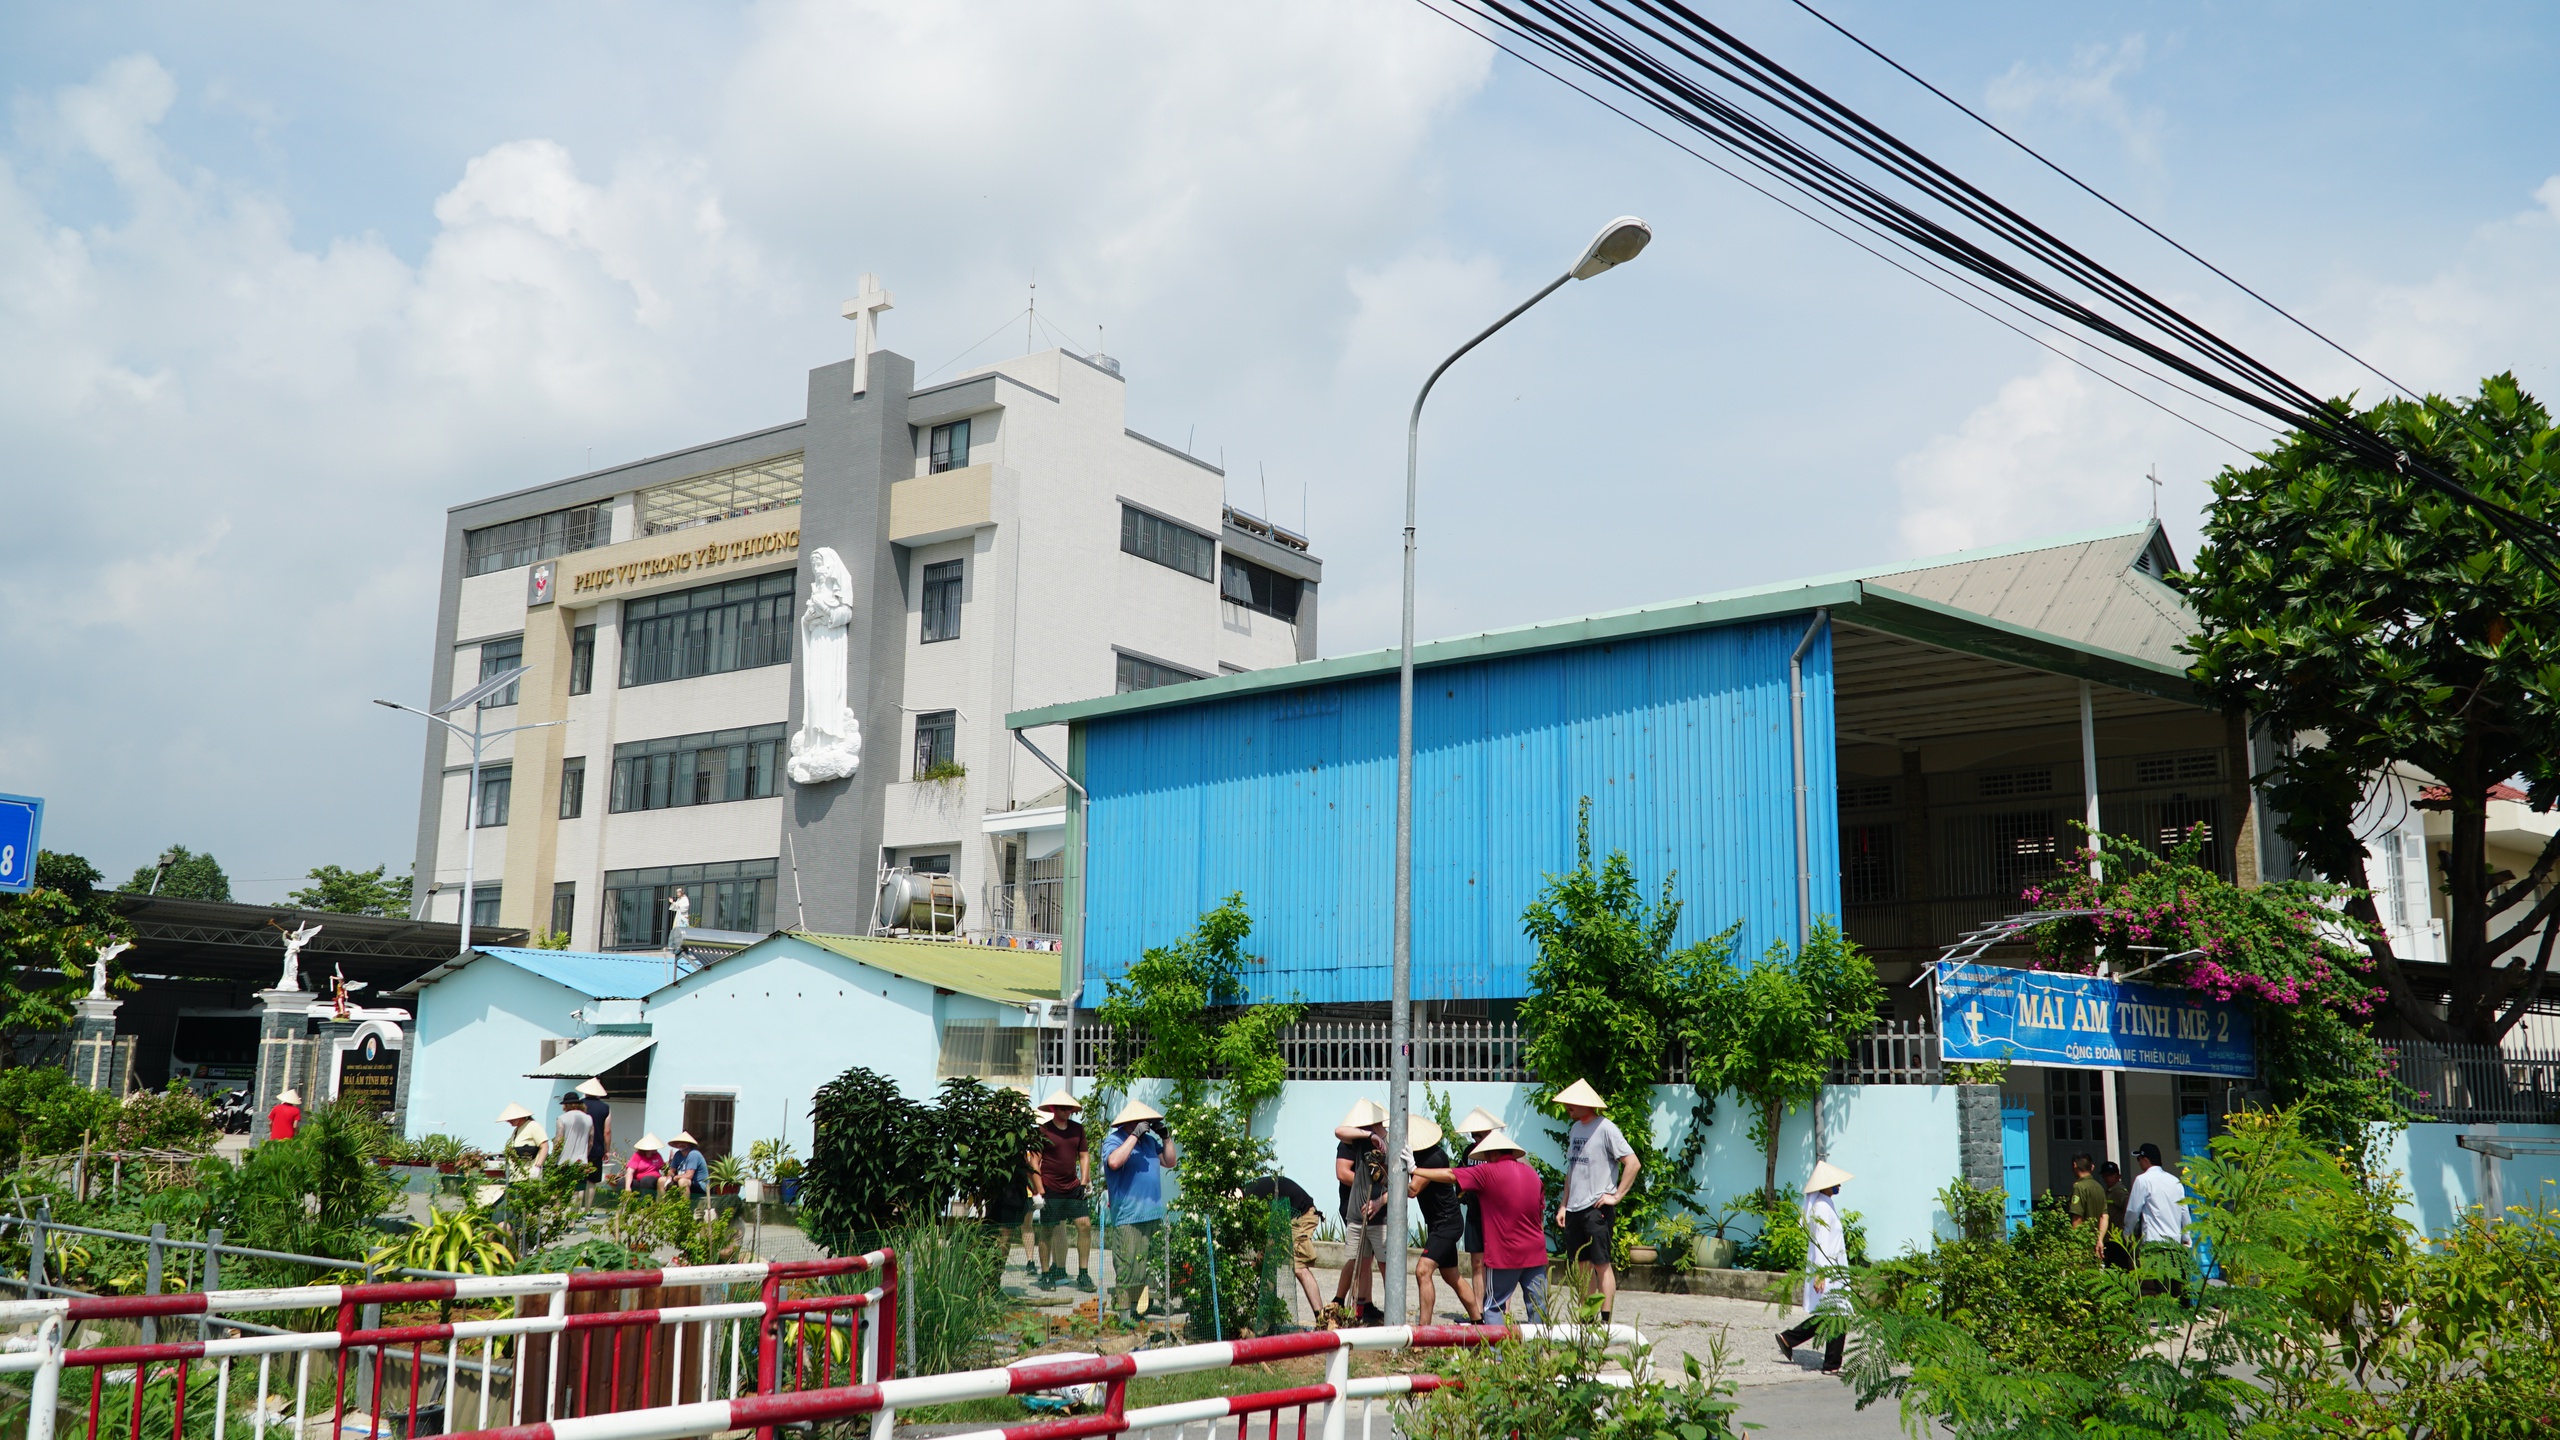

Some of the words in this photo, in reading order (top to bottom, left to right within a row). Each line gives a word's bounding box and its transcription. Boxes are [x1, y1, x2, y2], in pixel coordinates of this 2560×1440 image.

[574, 568, 615, 587] PHỤC
[617, 563, 638, 583] VỤ
[640, 552, 692, 577] TRONG
[695, 541, 729, 566] YÊU
[730, 530, 800, 559] THƯƠNG
[0, 844, 15, 877] 8
[2018, 986, 2066, 1030] MÁI
[2072, 983, 2110, 1033] ẤM
[2116, 994, 2171, 1038] TÌNH
[2177, 1007, 2210, 1049] MẸ
[2217, 1011, 2229, 1043] 2
[2065, 1042, 2093, 1060] CỘNG
[2095, 1044, 2122, 1061] ĐOÀN
[2123, 1048, 2137, 1064] MẸ
[2139, 1047, 2165, 1064] THIÊN
[2167, 1050, 2192, 1066] CHÚA
